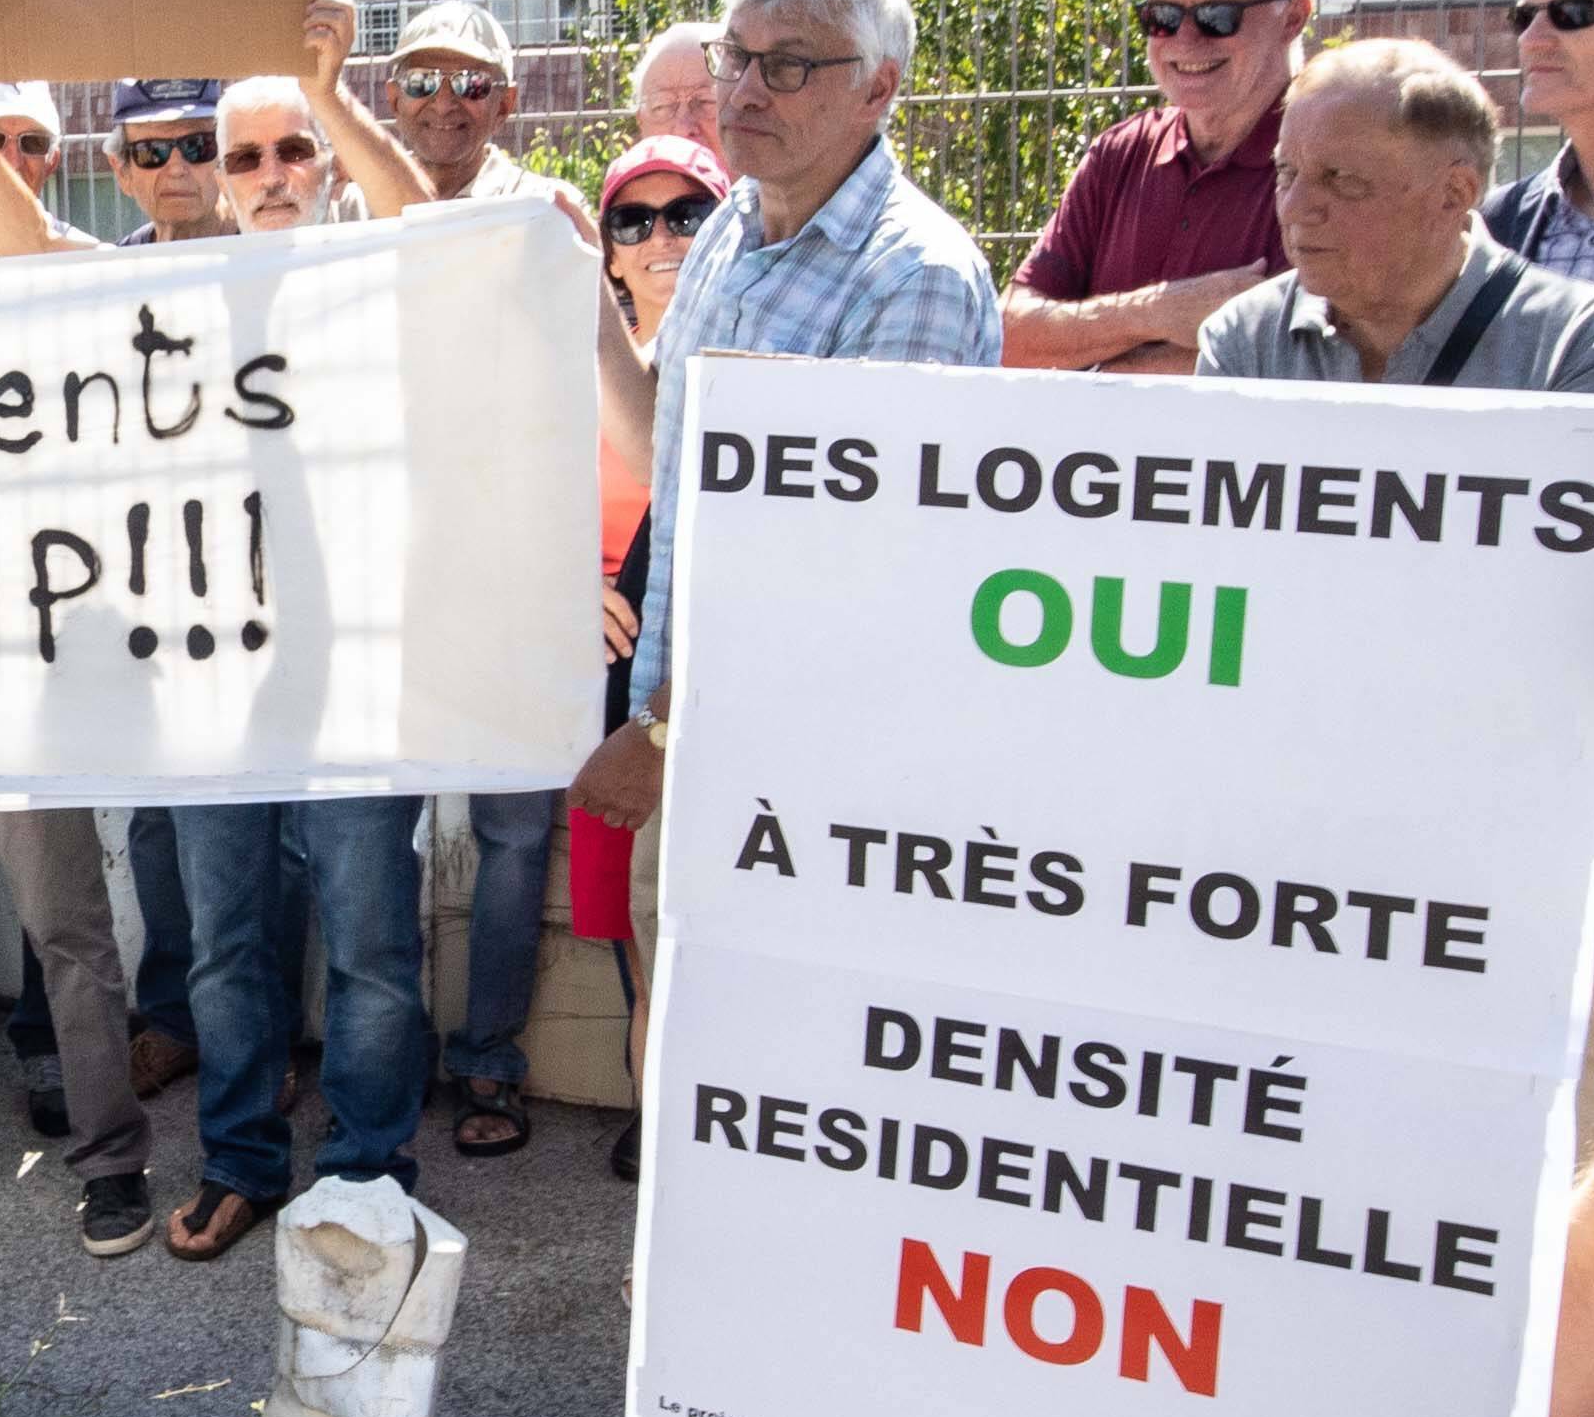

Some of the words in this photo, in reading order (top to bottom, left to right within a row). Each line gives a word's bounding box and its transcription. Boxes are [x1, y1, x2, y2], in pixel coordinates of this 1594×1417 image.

[700, 430, 880, 504] DES
[970, 568, 1249, 688] OUI
[734, 798, 797, 879] À
[828, 824, 1086, 918] TRÈS
[1125, 861, 1490, 973] FORTE
[861, 1005, 1308, 1143] DENSITÉ
[692, 1083, 1500, 1298] RESIDENTIELLE
[894, 1236, 1223, 1399] NON
[659, 1395, 681, 1413] Le
